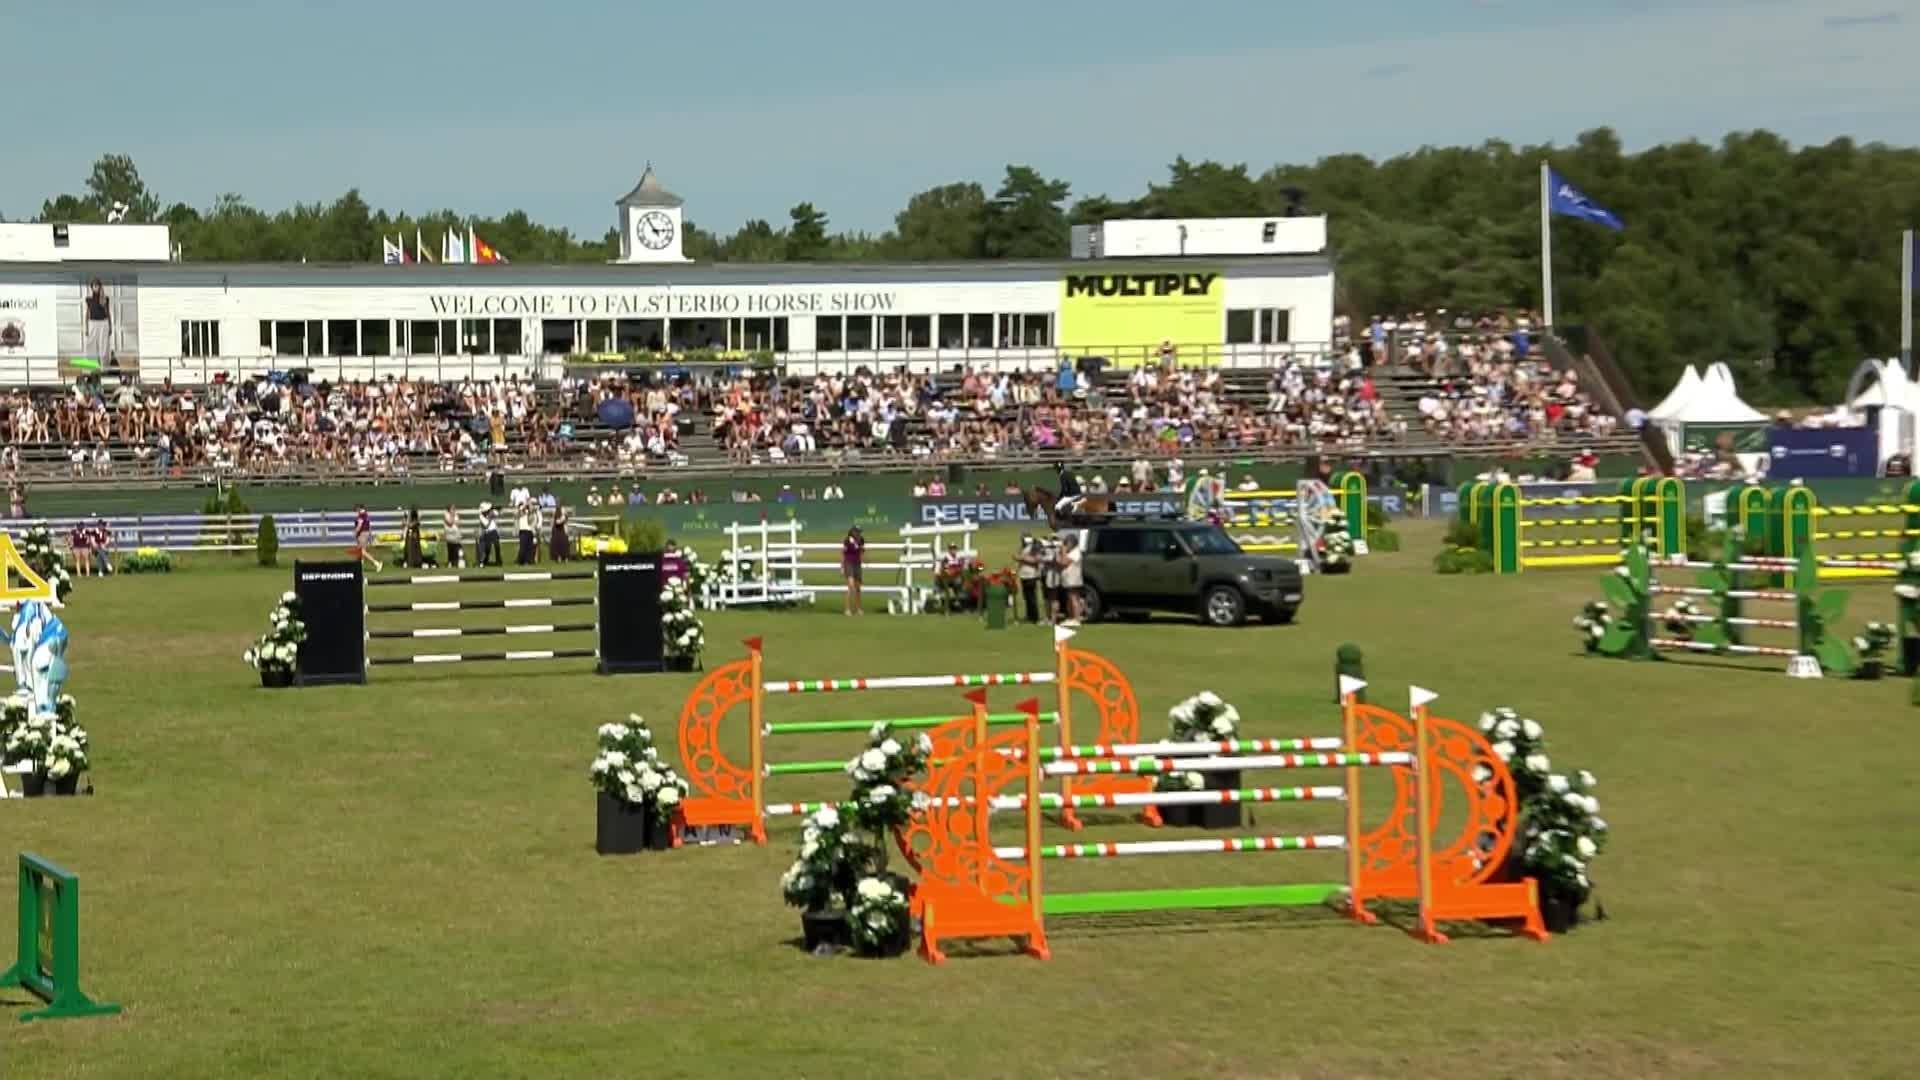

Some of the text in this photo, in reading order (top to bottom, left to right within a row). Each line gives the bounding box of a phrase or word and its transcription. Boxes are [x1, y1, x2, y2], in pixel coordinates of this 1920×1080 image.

[1066, 273, 1220, 297] MULTIPLY
[430, 292, 897, 314] WELCOME TO FALSTERBO HORSE SHOW
[921, 503, 1048, 521] DEFEND
